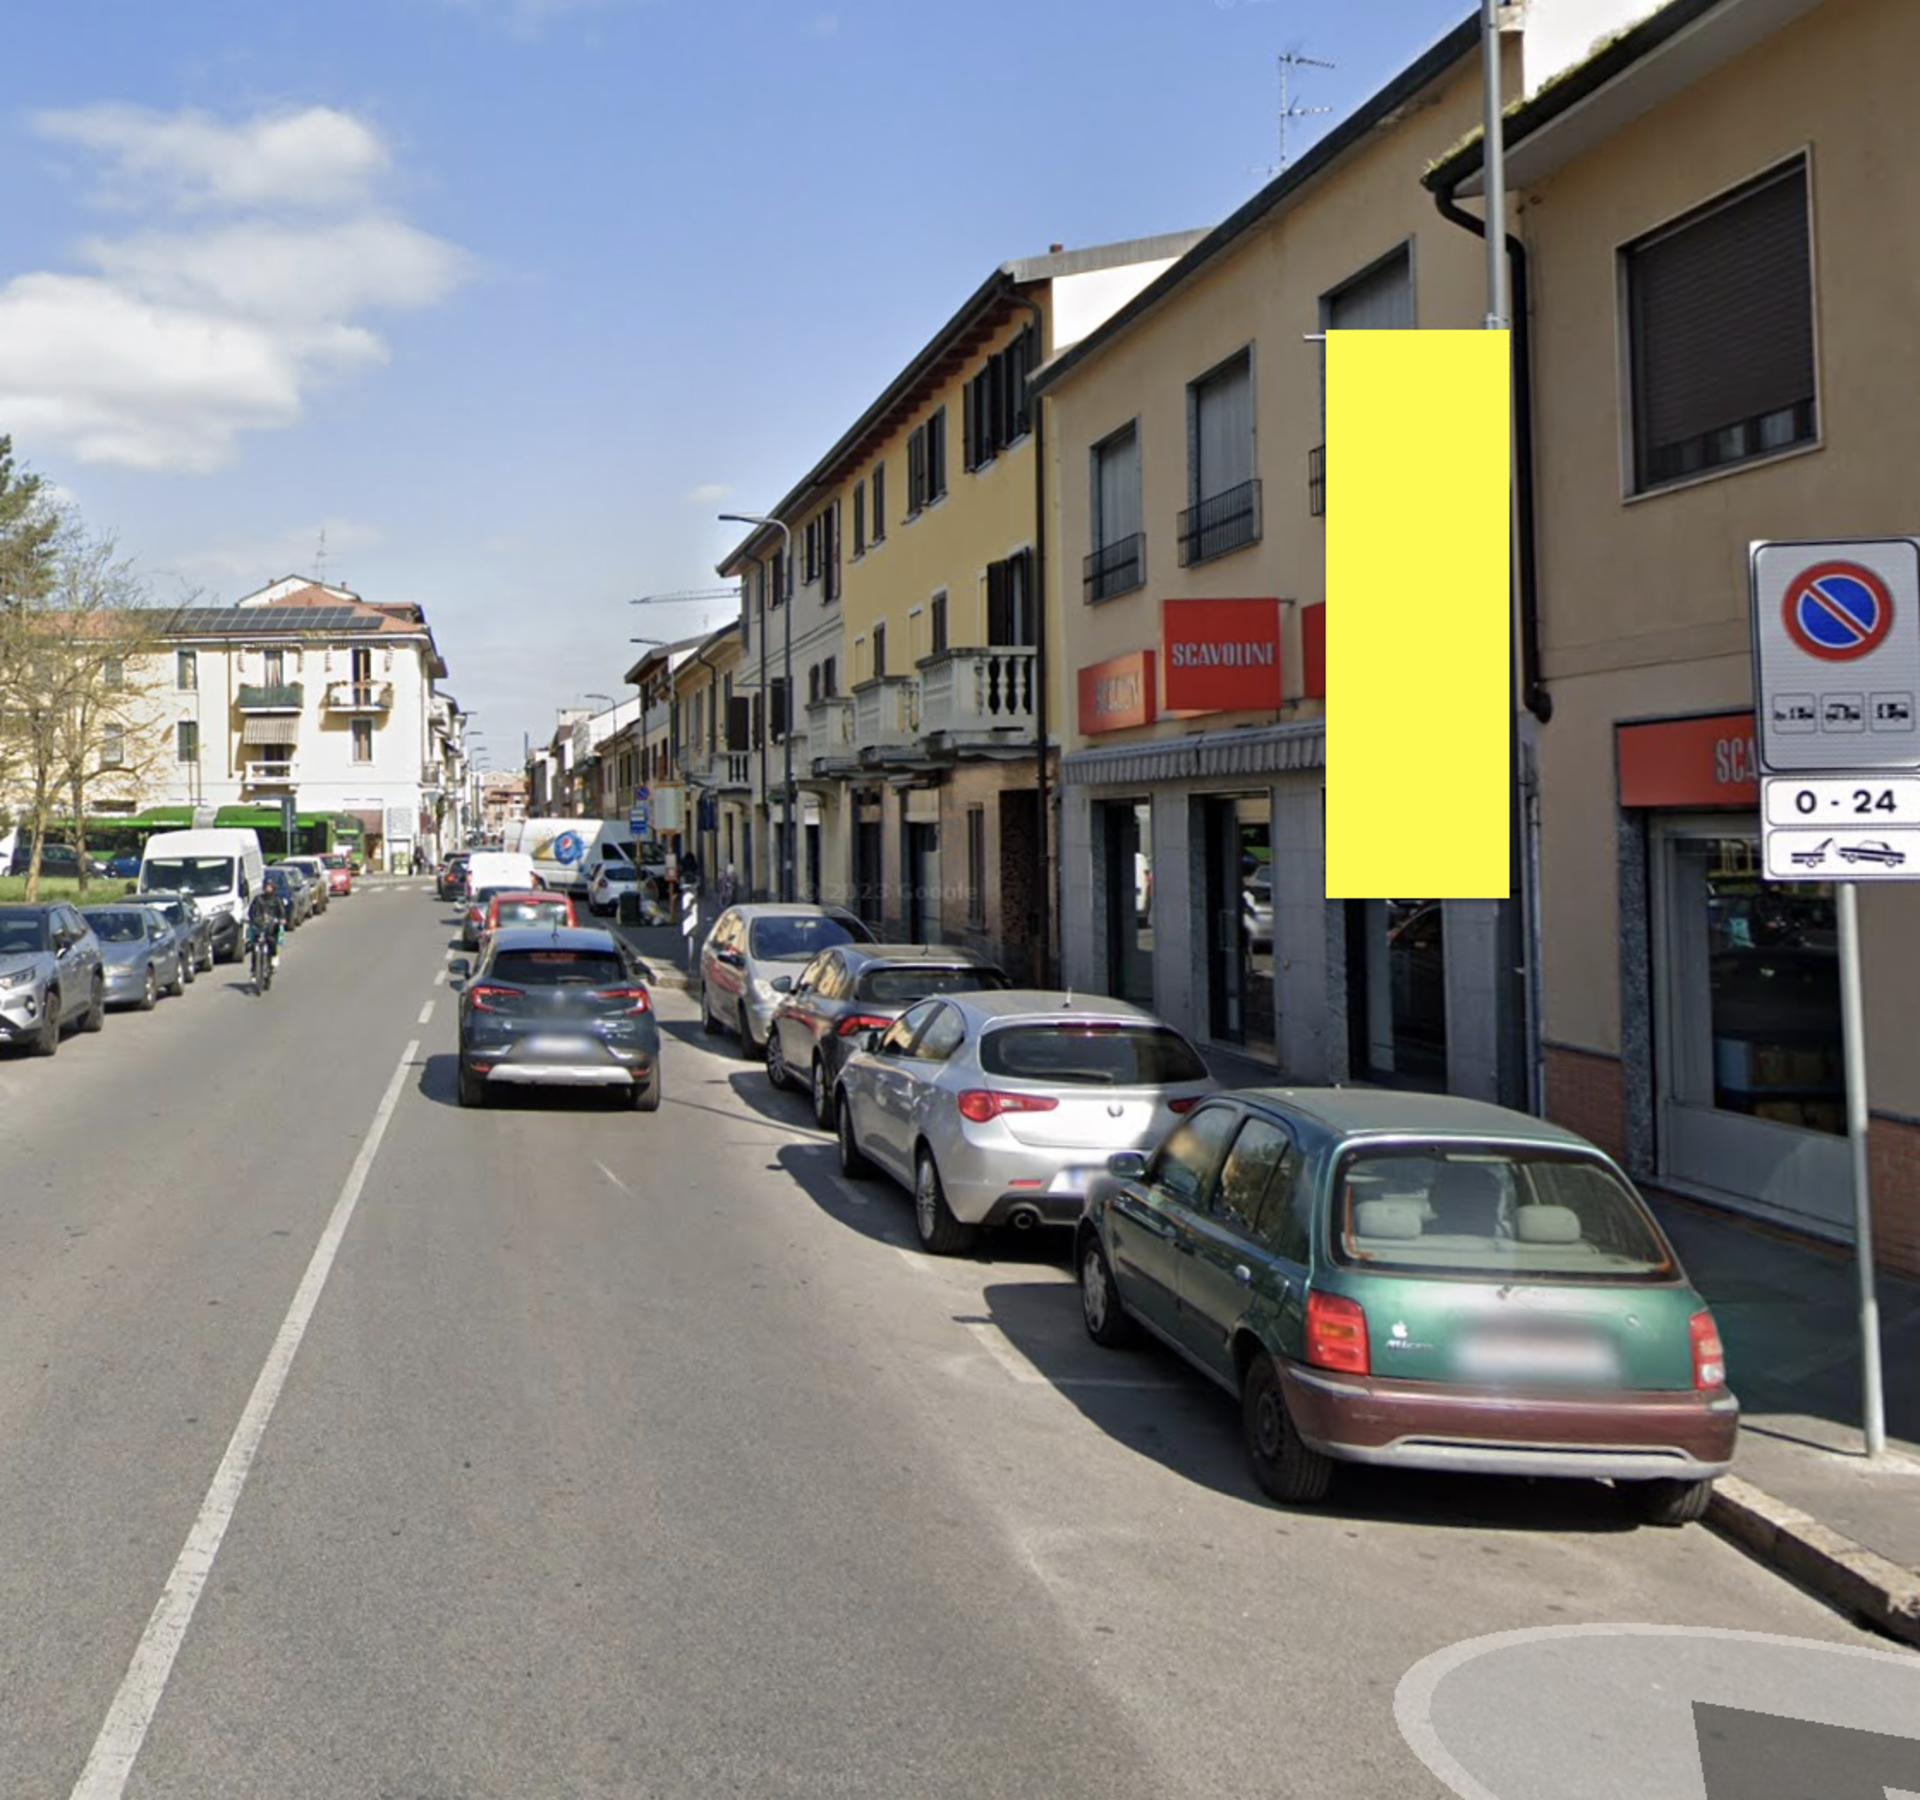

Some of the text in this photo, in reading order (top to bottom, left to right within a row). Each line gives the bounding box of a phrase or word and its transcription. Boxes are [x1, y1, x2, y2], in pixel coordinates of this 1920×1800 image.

[1172, 643, 1273, 666] SCAVOLINI
[1715, 738, 1758, 784] SCA
[1795, 790, 1817, 815] 0
[1852, 789, 1897, 814] 24
